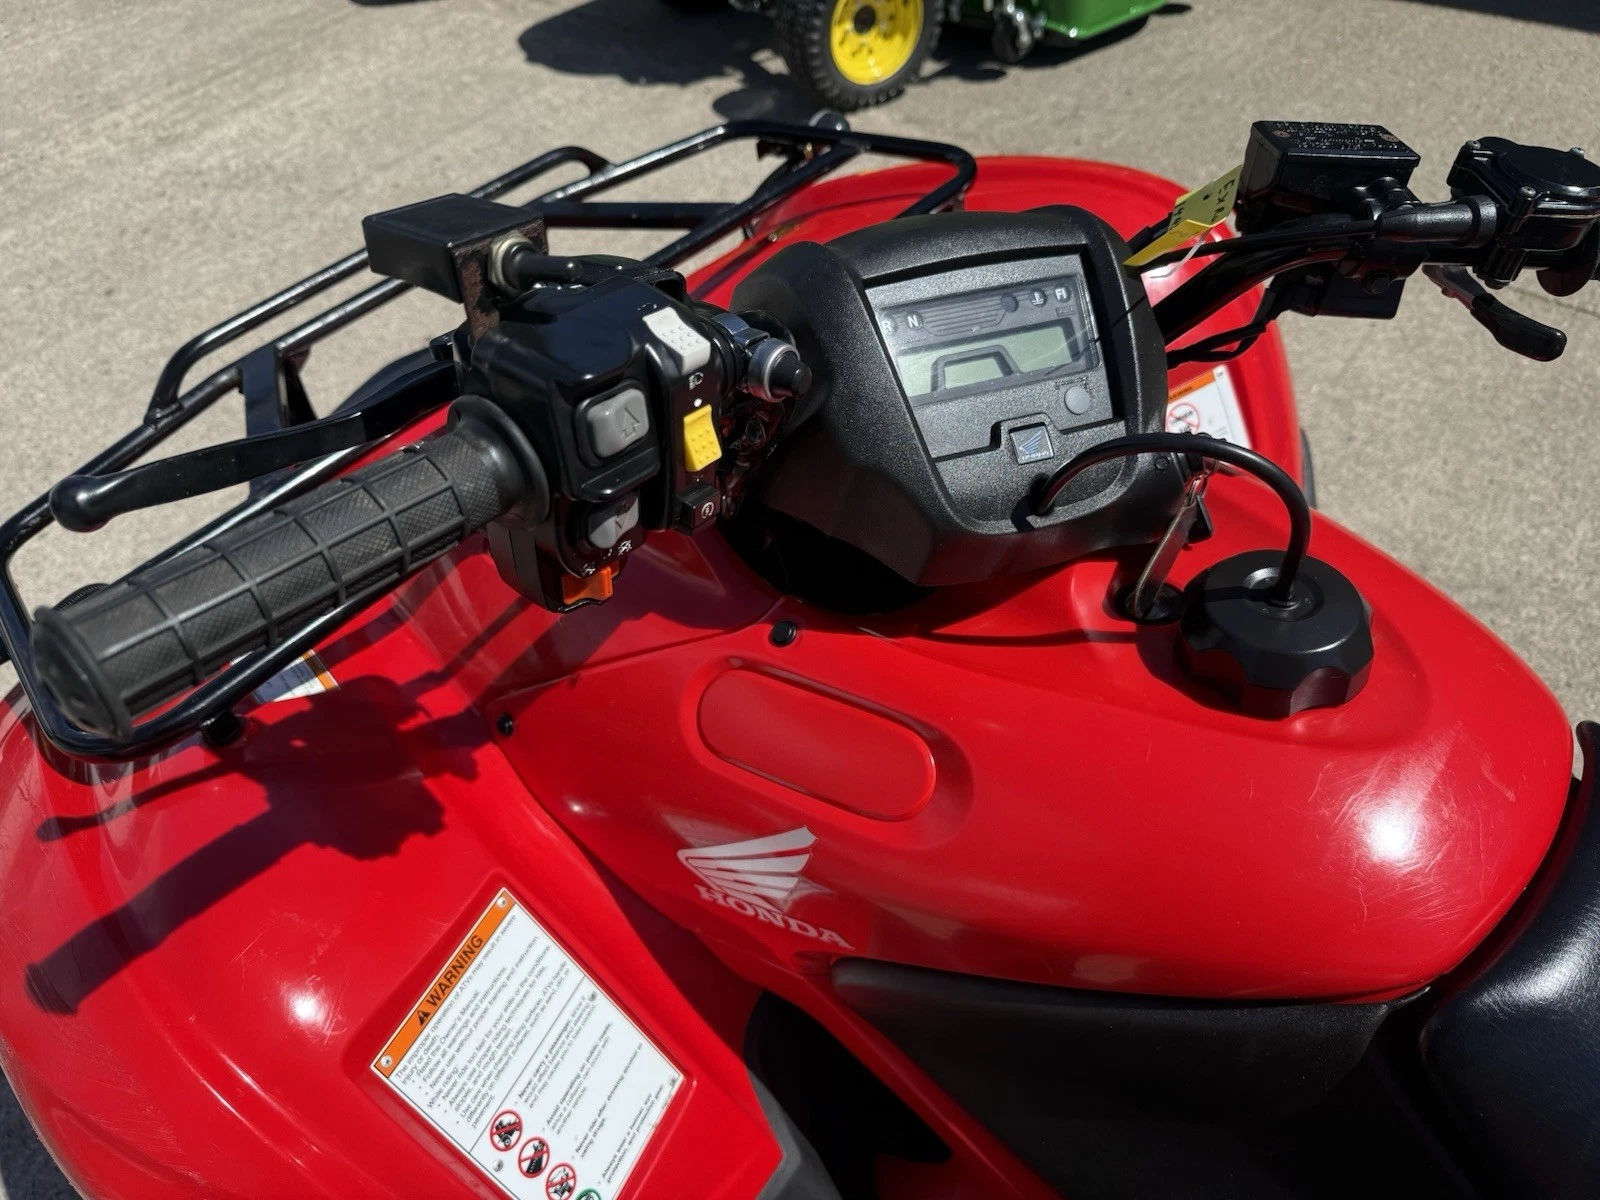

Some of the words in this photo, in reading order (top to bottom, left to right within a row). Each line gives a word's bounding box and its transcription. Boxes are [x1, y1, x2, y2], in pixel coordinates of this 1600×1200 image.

[880, 317, 892, 333] R
[907, 314, 920, 327] N
[1055, 288, 1067, 300] FI
[694, 883, 856, 951] HONDA
[394, 1063, 408, 1079] The
[405, 1030, 433, 1066] improper
[428, 998, 456, 1034] operation
[452, 990, 461, 1001] of
[458, 973, 473, 992] ATVs
[471, 959, 484, 976] may
[481, 940, 497, 961] result
[494, 932, 502, 943] in
[499, 914, 517, 936] severe
[425, 932, 484, 1009] WARNING
[421, 1057, 442, 1083] Follow
[439, 1047, 449, 1059] all
[445, 1016, 471, 1050] warnings
[467, 1002, 481, 1018] and
[428, 1066, 447, 1090] Never
[445, 1052, 457, 1068] use
[453, 1026, 474, 1054] without
[472, 1005, 491, 1029] proper
[487, 979, 508, 1007] training
[504, 966, 516, 982] and
[513, 932, 540, 968] instruction.
[441, 1077, 459, 1101] Never
[456, 1062, 469, 1079] ride
[466, 1050, 478, 1065] too
[475, 1037, 487, 1052] fast
[484, 1027, 494, 1039] for
[492, 1012, 506, 1030] your
[502, 994, 516, 1013] skills
[514, 987, 522, 997] or
[519, 975, 529, 989] the
[447, 1079, 468, 1108] Always
[465, 1066, 477, 1081] use
[475, 1043, 494, 1068] proper
[490, 1022, 507, 1045] riding
[503, 987, 531, 1025] techniques
[528, 977, 537, 989] for
[459, 1102, 472, 1118] Use
[469, 1087, 482, 1104] care
[479, 1068, 494, 1088] when
[491, 1038, 515, 1072] changing
[511, 1021, 527, 1042] riding
[540, 978, 554, 997] ATVs
[551, 959, 568, 981] handle
[563, 1025, 575, 1040] and
[400, 1062, 419, 1086] injury
[416, 1054, 425, 1065] or
[421, 1031, 441, 1056] death.
[415, 1055, 433, 1077] Read
[429, 1043, 441, 1057] the
[438, 1014, 462, 1045] Owner's
[464, 1089, 490, 1124] differently
[487, 1080, 495, 1091] on
[492, 1053, 512, 1081] different
[528, 1010, 541, 1028] such
[539, 1003, 547, 1012] as
[426, 1086, 444, 1109] While
[441, 1063, 461, 1089] riding:
[452, 1084, 474, 1113] slopes,
[470, 1069, 483, 1086] and
[480, 1048, 499, 1072] rough
[517, 1076, 534, 1099] Never
[532, 1059, 547, 1079] carry
[527, 1093, 539, 1109] and
[537, 1079, 549, 1096] may
[545, 1103, 561, 1126] Avoid
[558, 1071, 581, 1106] operating
[579, 1061, 587, 1072] on
[574, 1132, 589, 1154] Never
